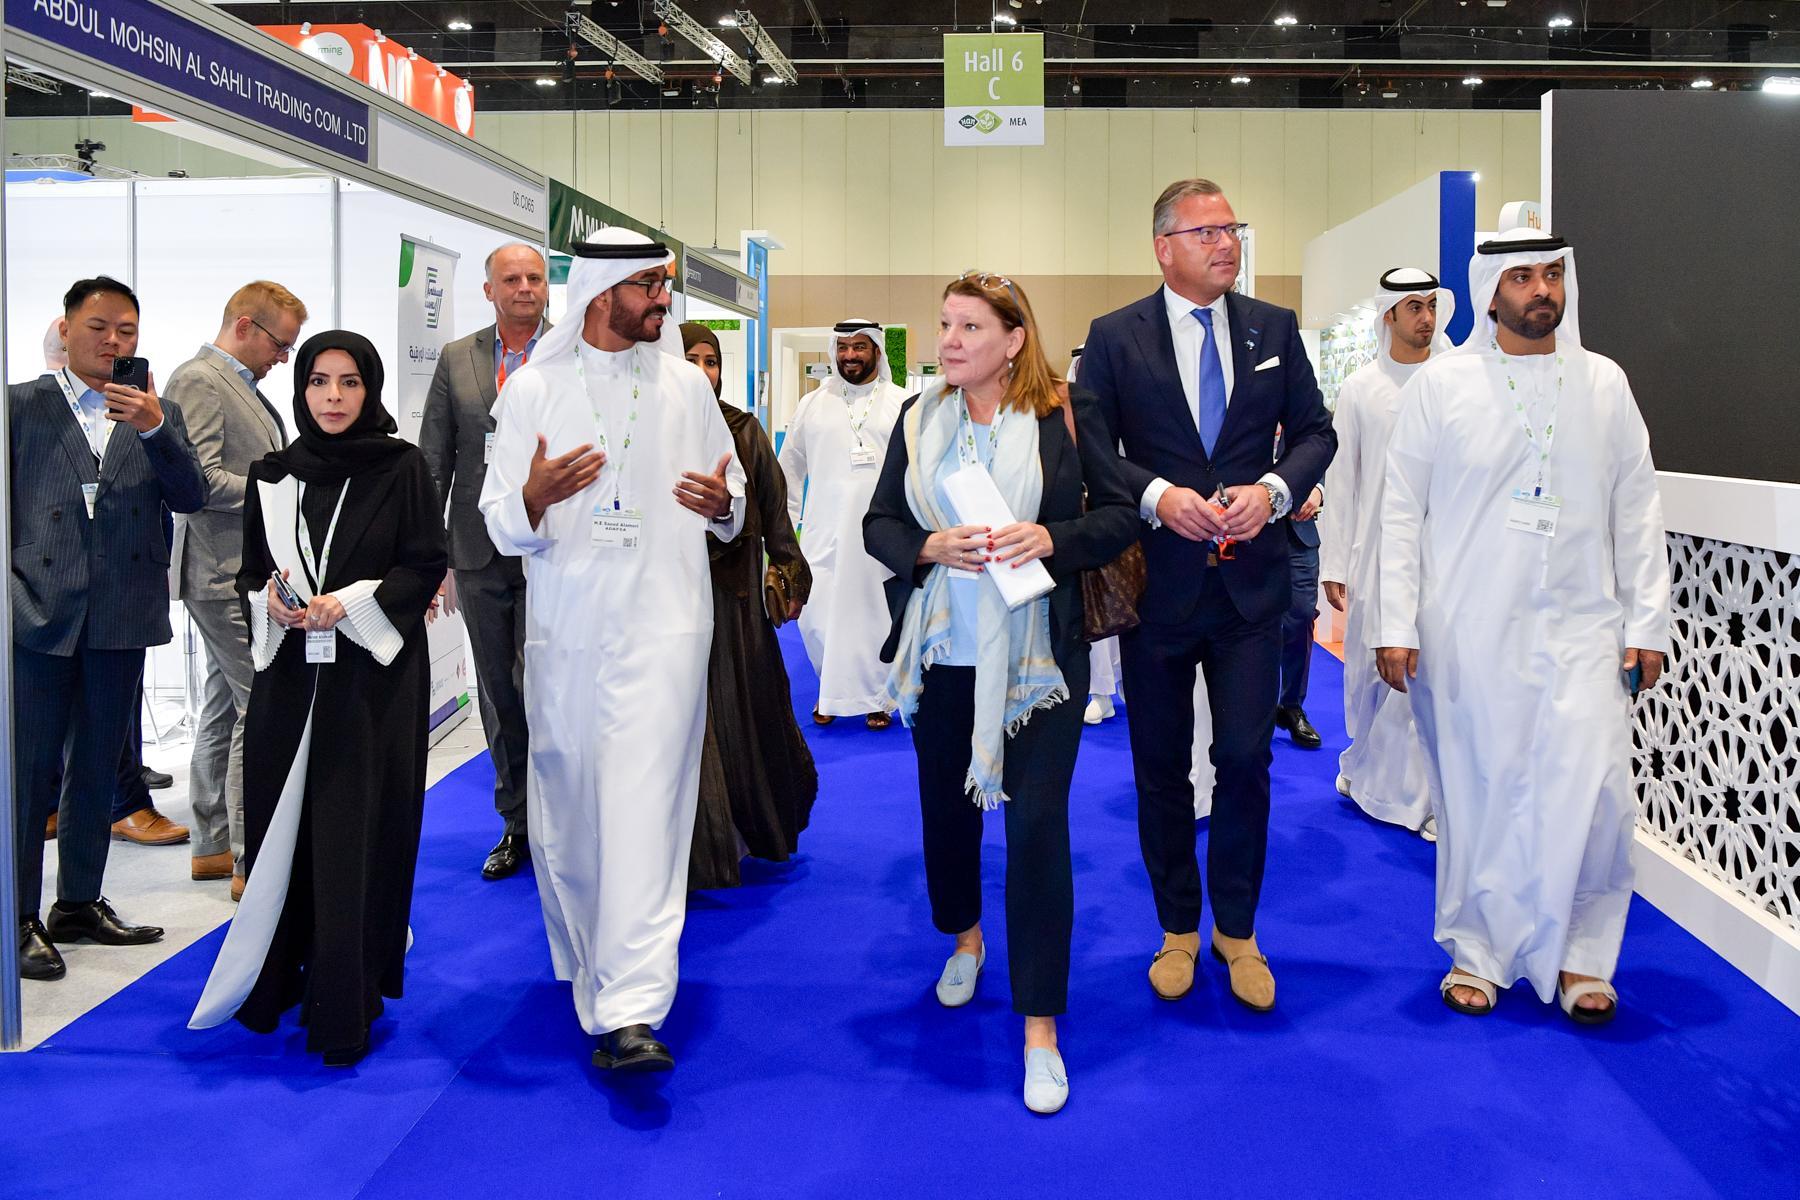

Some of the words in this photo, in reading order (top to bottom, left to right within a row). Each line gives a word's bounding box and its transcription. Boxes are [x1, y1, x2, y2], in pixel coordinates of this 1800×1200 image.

[964, 48, 1003, 72] Hall
[1011, 50, 1024, 72] 6
[33, 0, 105, 39] ABDUL
[110, 17, 181, 71] MOHSIN
[185, 51, 206, 81] AL
[209, 61, 251, 100] SAHLI
[254, 80, 312, 124] TRADING
[314, 107, 341, 136] COM
[343, 120, 366, 145] .LTD
[988, 76, 1001, 100] C
[1009, 118, 1027, 126] MEA
